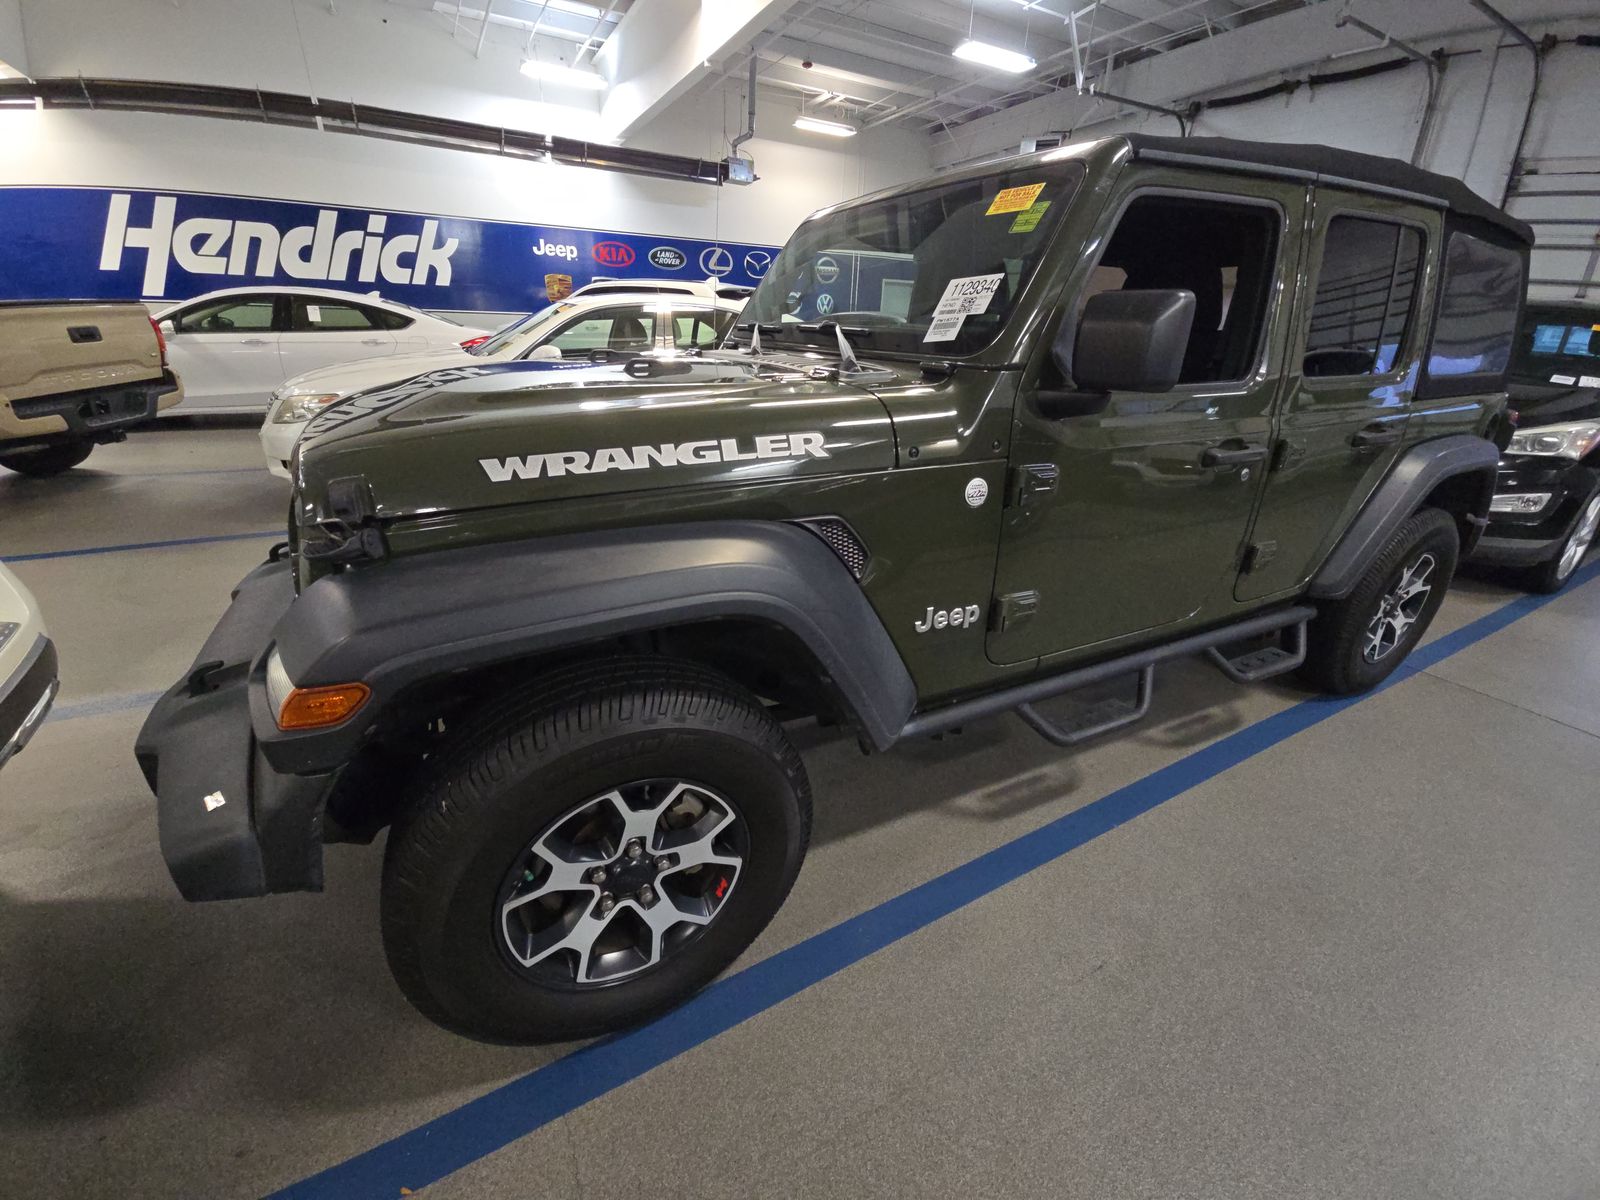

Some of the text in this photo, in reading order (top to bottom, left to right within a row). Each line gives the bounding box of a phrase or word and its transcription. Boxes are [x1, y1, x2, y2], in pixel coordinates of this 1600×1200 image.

[99, 194, 459, 297] Hendrick
[532, 239, 577, 261] Jeep
[600, 247, 629, 262] KIA
[657, 251, 675, 259] LAND
[951, 278, 1001, 297] 1129340
[478, 432, 830, 483] WRANGLER
[915, 604, 980, 633] Jeep
